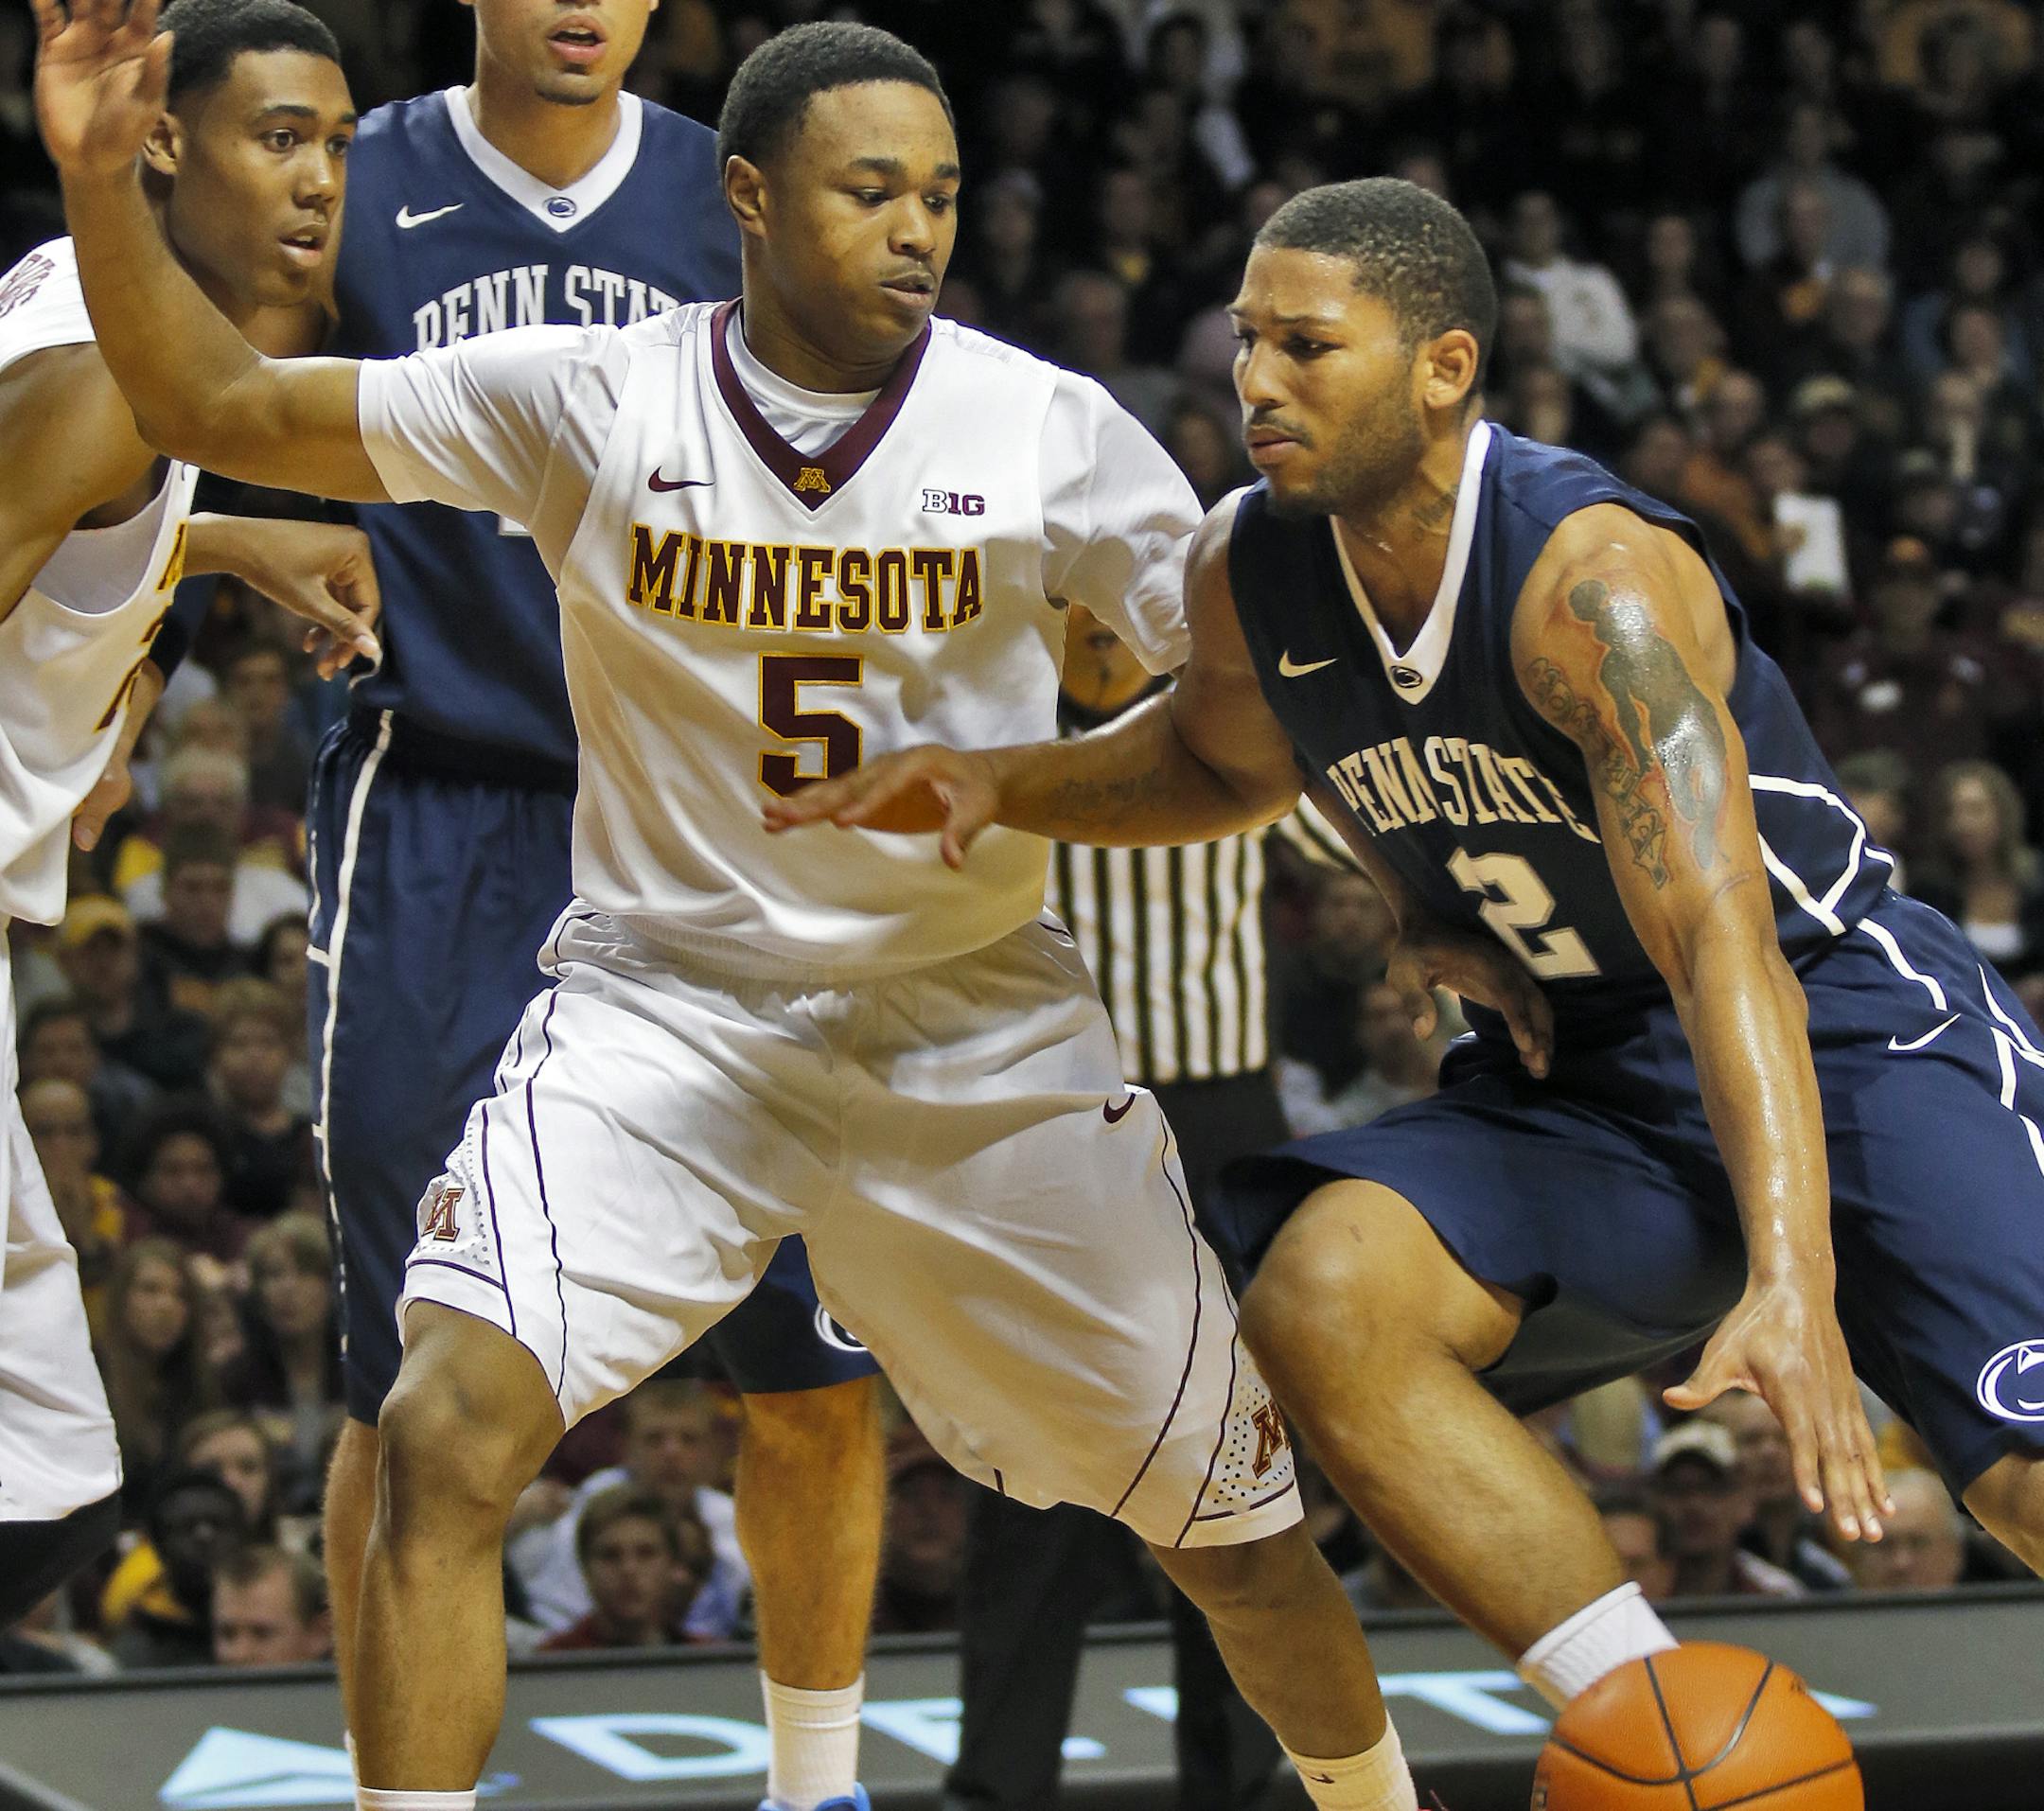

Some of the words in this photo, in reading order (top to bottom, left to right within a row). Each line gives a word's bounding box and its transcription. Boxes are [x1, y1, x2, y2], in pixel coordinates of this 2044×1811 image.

[413, 264, 549, 353] PENN
[626, 521, 984, 634] MINNESOTA
[759, 650, 865, 799] 5
[1445, 846, 1603, 980] 2
